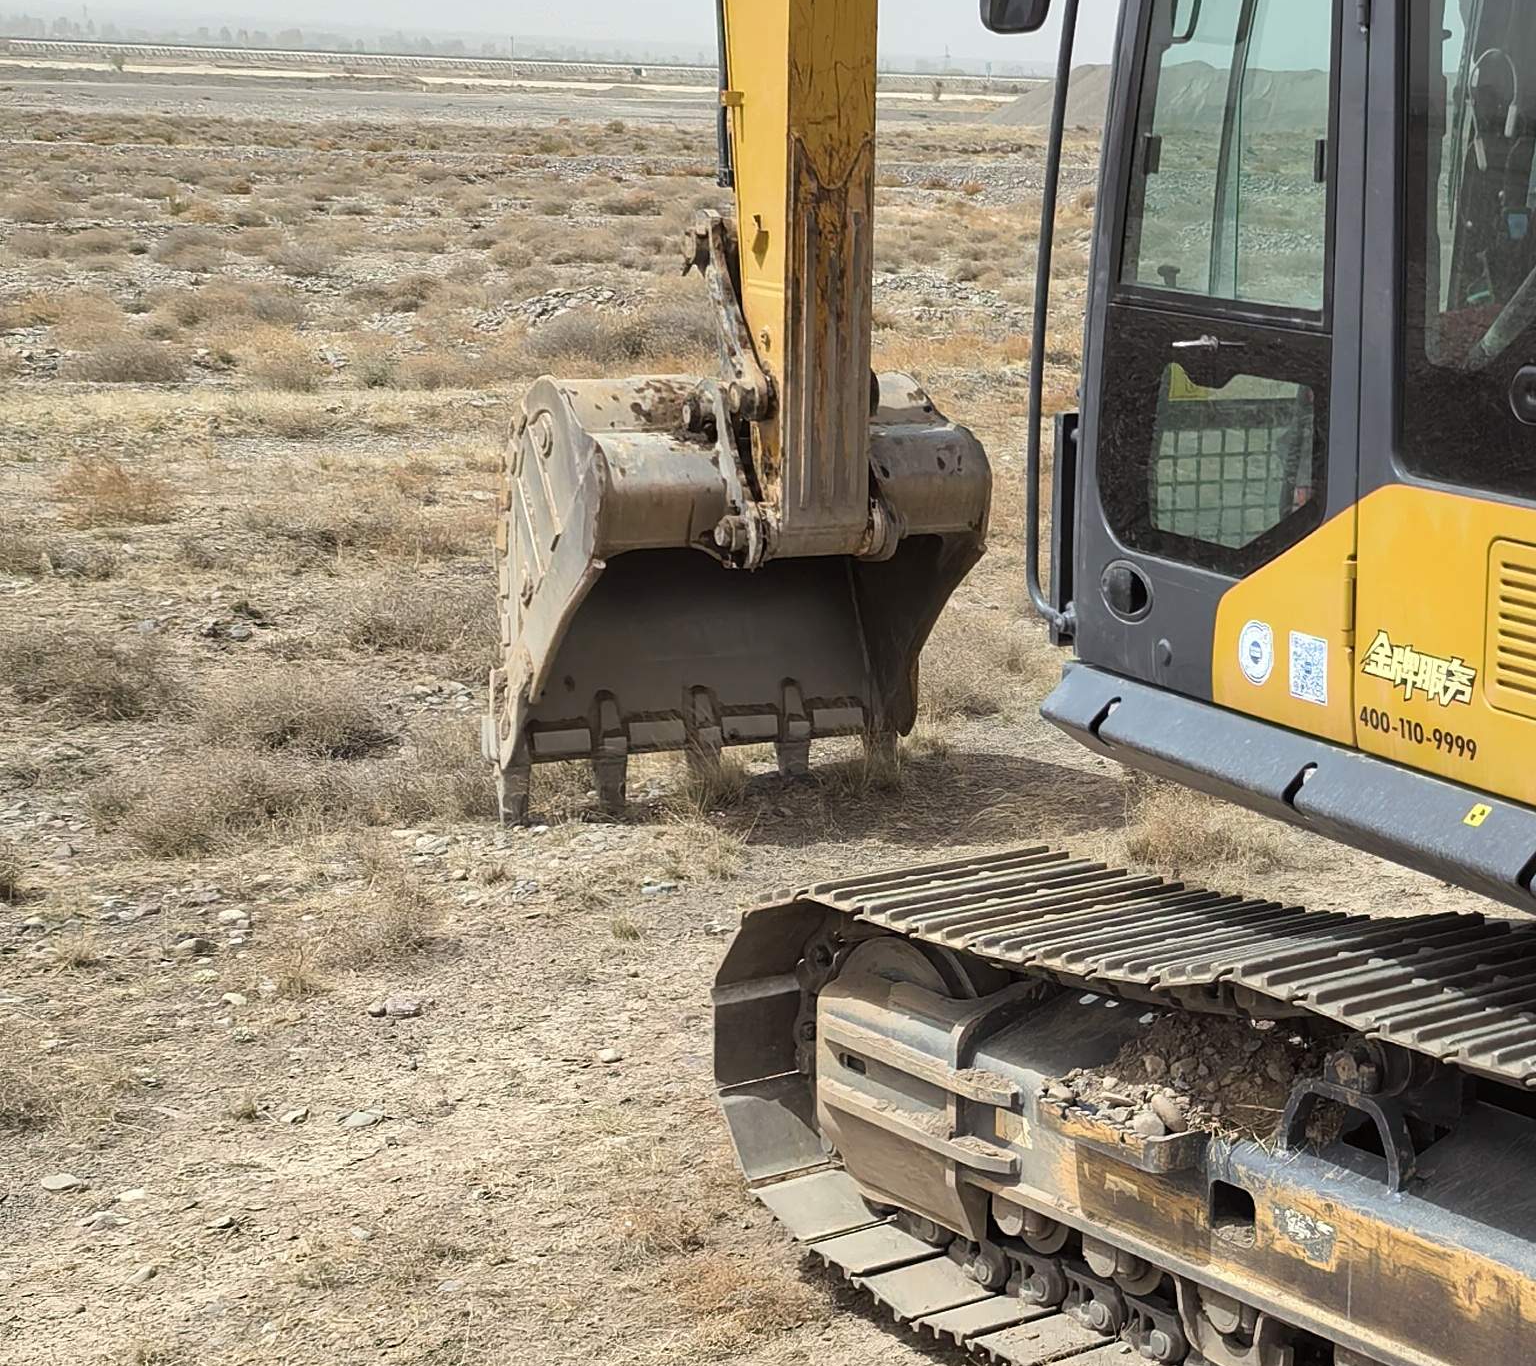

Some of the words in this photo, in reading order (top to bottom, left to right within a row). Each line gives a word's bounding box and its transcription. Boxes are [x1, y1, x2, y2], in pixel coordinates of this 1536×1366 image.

[1360, 629, 1477, 707] 金牌服务
[1360, 706, 1477, 761] 400-110-9999
